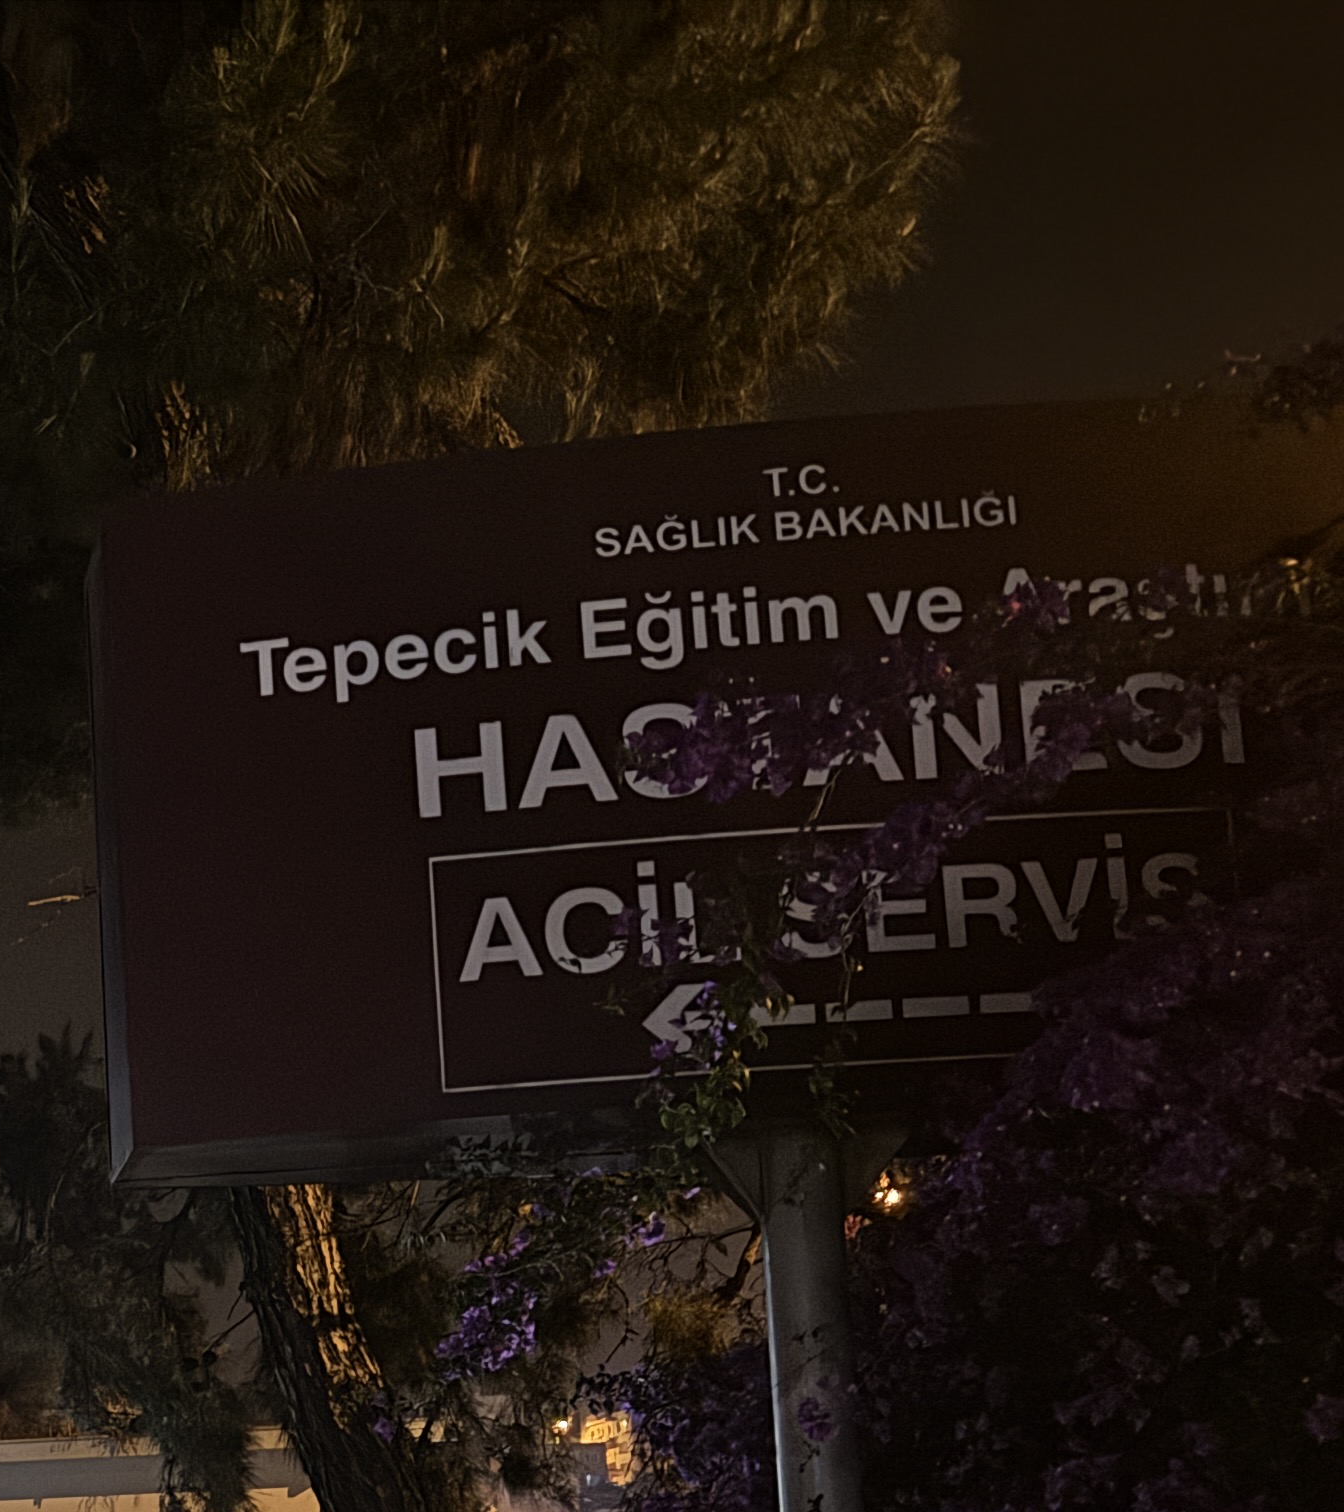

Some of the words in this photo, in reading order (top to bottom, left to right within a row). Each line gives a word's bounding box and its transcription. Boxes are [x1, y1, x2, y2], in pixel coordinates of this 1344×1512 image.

[594, 512, 758, 558] SAĞLIK
[772, 490, 1019, 546] BAKANLIĞI
[762, 464, 840, 499] T.C.
[240, 609, 551, 704] Tepecik
[580, 585, 840, 672] Eğitim
[868, 585, 964, 637] ve
[458, 860, 742, 983] ACİL
